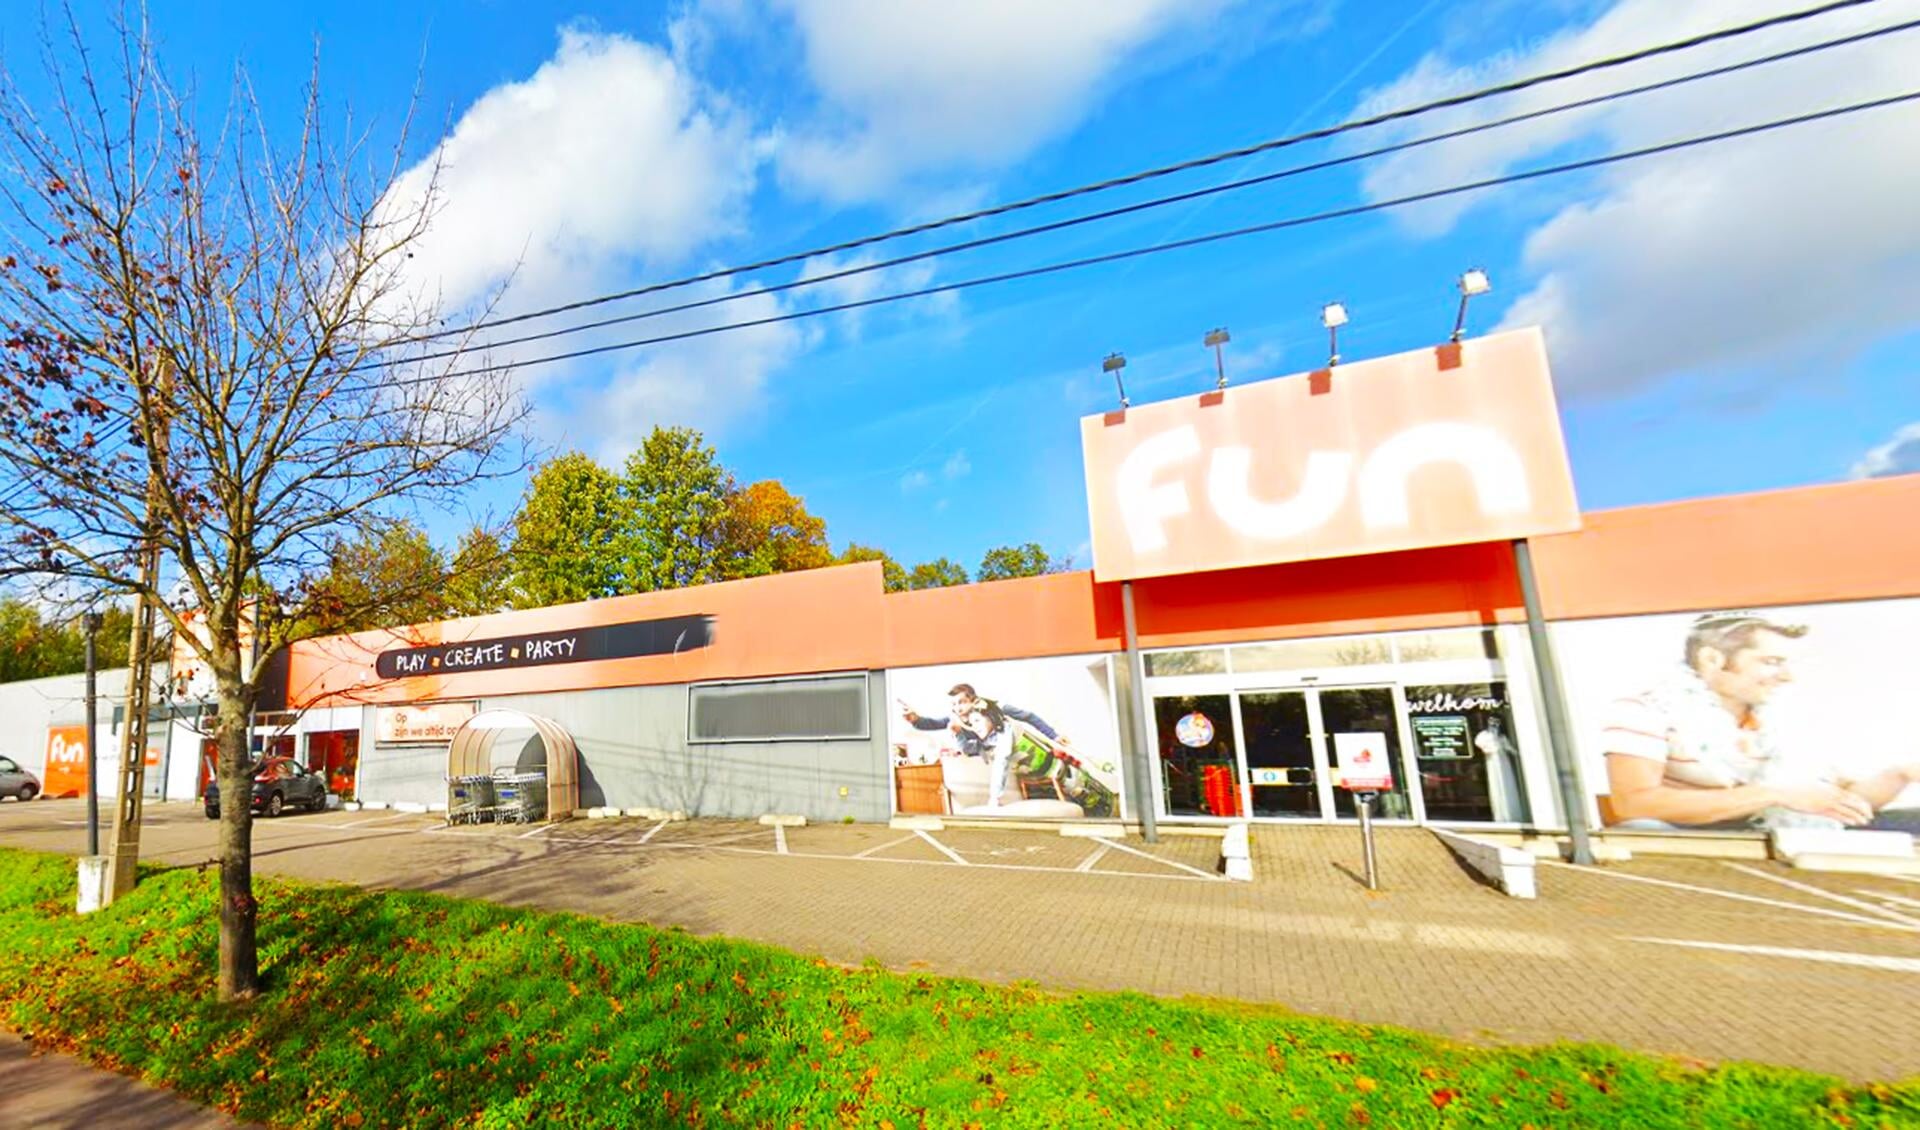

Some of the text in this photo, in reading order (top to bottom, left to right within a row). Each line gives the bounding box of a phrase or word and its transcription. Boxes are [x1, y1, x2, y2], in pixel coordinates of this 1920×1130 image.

[395, 636, 577, 671] PLAY CREATE PARTY
[394, 712, 408, 724] Op
[394, 726, 409, 738] zijn
[411, 728, 424, 737] we
[424, 724, 445, 737] altijd
[50, 733, 85, 763] fun
